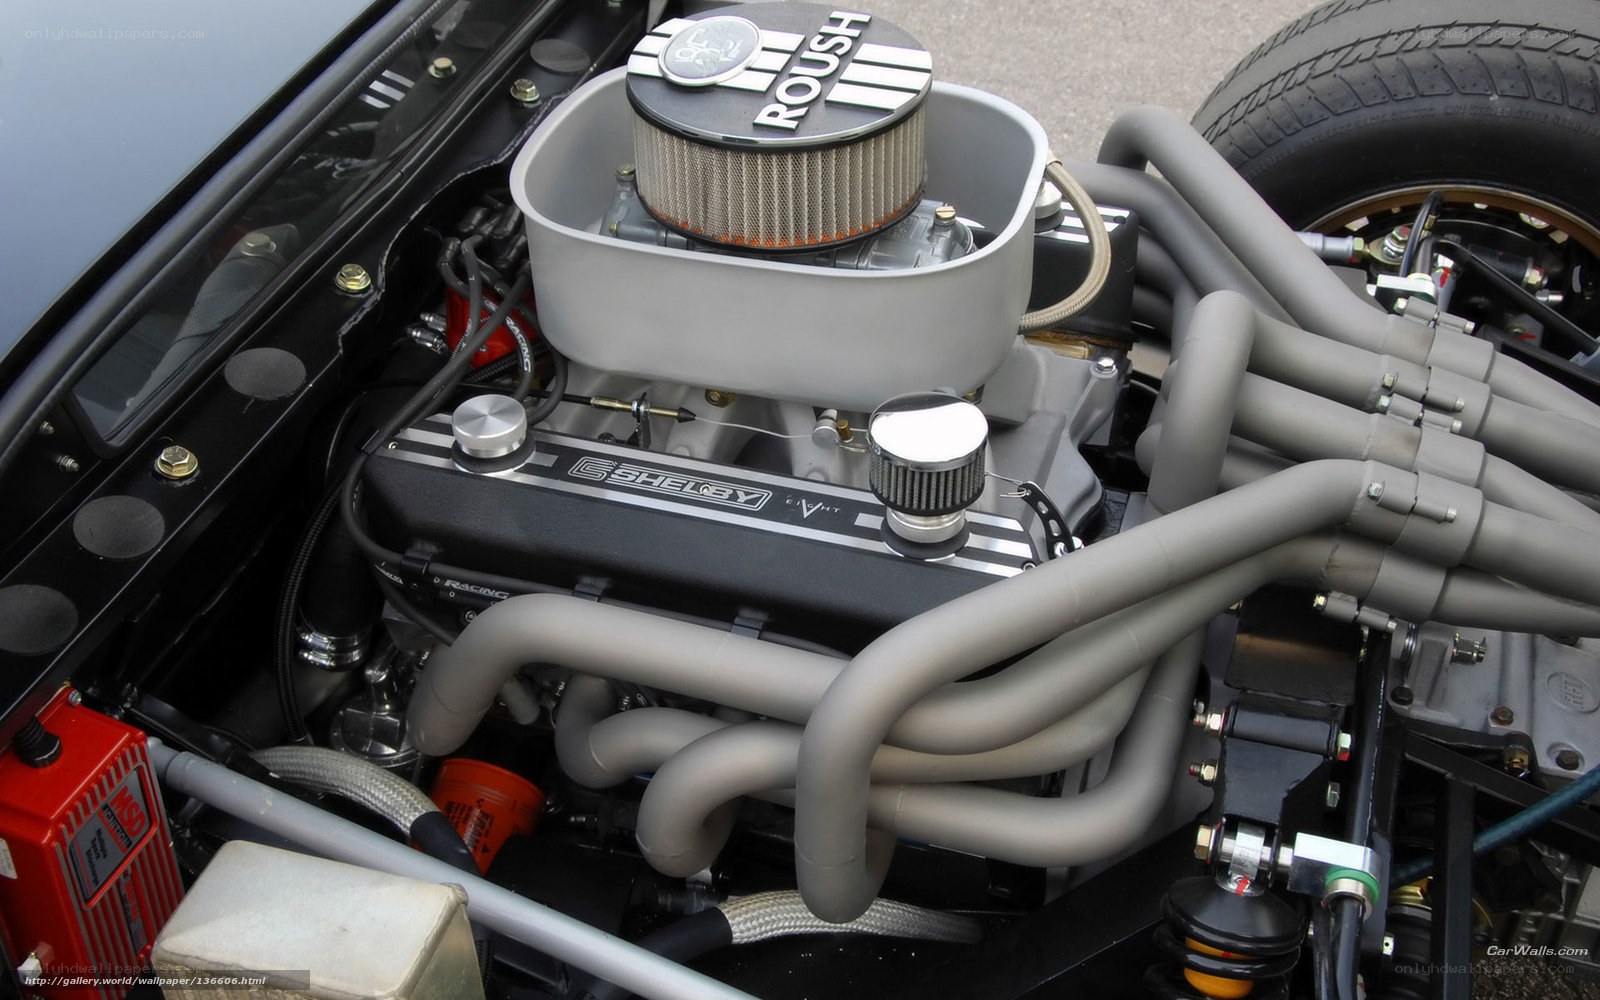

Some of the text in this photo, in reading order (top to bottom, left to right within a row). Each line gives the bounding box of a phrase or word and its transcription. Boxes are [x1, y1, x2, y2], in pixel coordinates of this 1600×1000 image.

[753, 11, 872, 131] ROUSH
[505, 316, 531, 373] RACING
[610, 468, 759, 504] SHELBY
[444, 579, 510, 599] RACING
[103, 808, 130, 848] IGNITION
[109, 785, 146, 837] MSD
